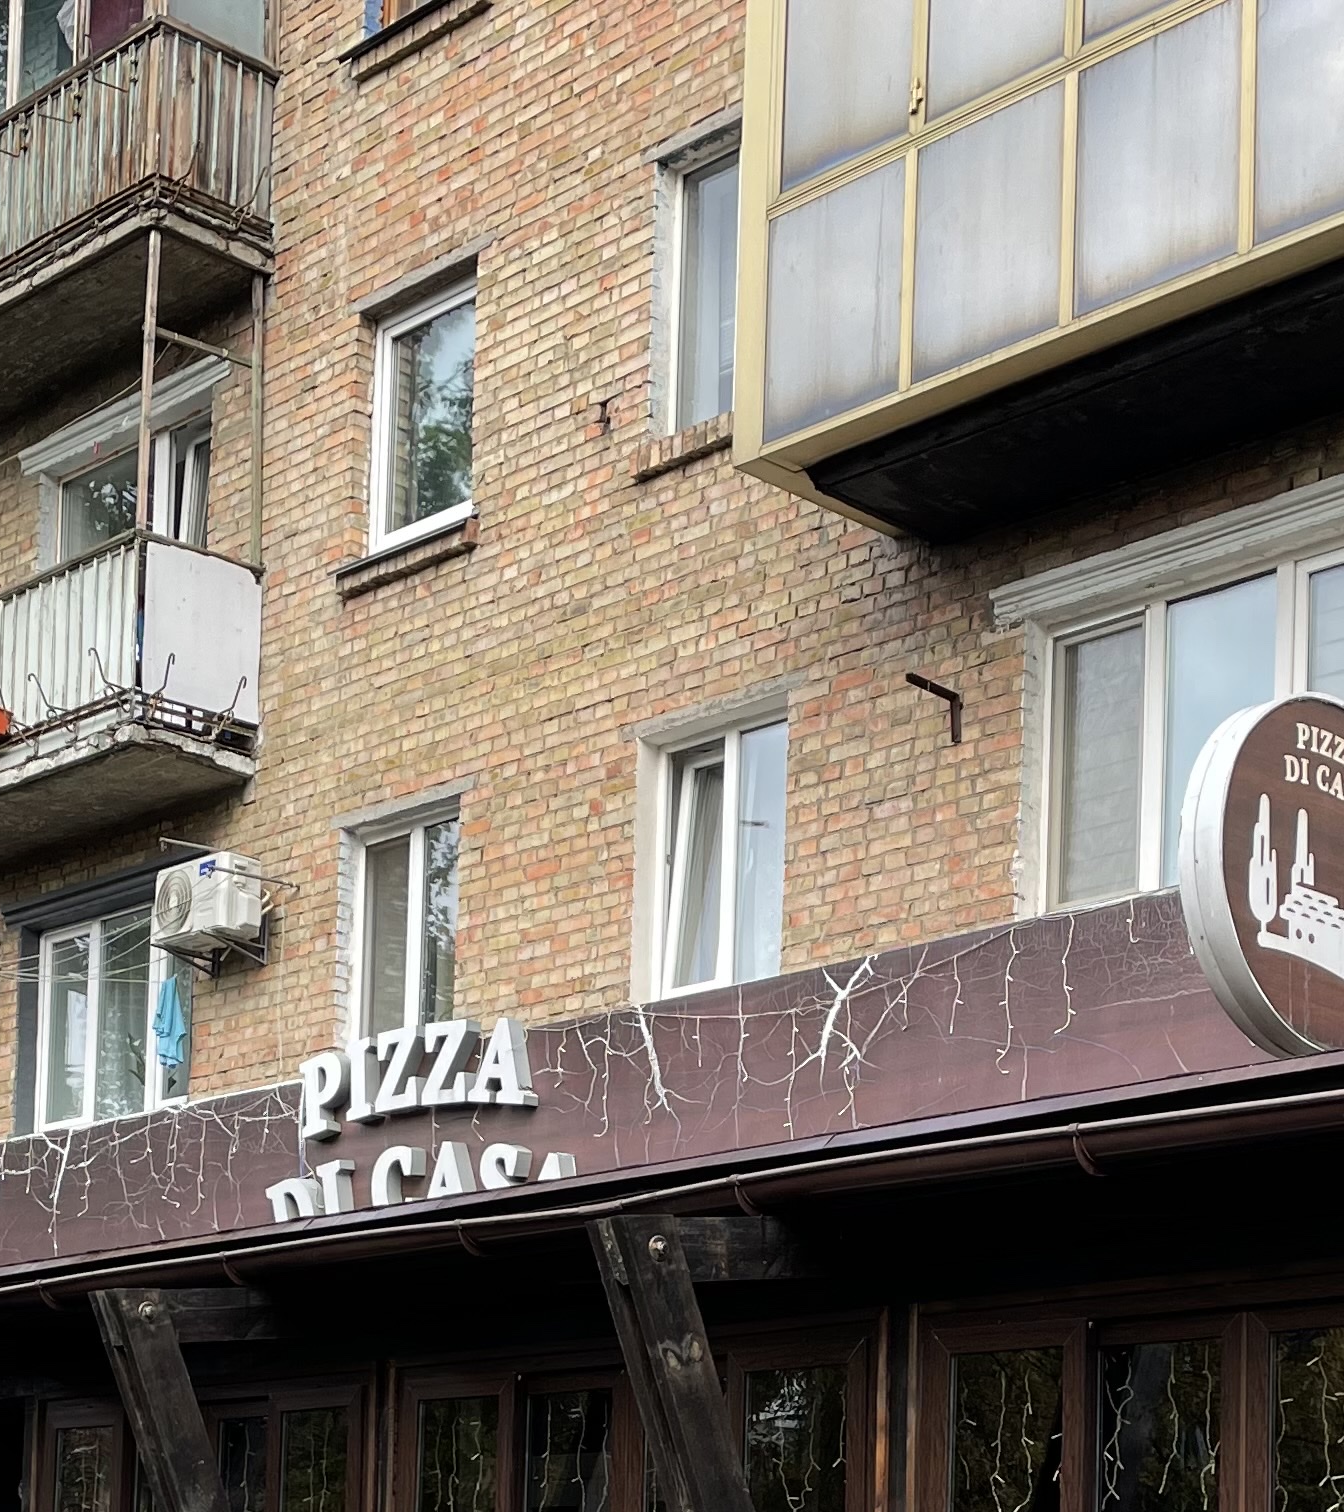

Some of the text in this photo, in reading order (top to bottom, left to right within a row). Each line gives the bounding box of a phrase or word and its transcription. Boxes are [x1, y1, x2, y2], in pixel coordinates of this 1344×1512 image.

[1283, 754, 1309, 785] DI
[298, 1017, 539, 1141] PIZZA
[265, 1158, 356, 1223] DI
